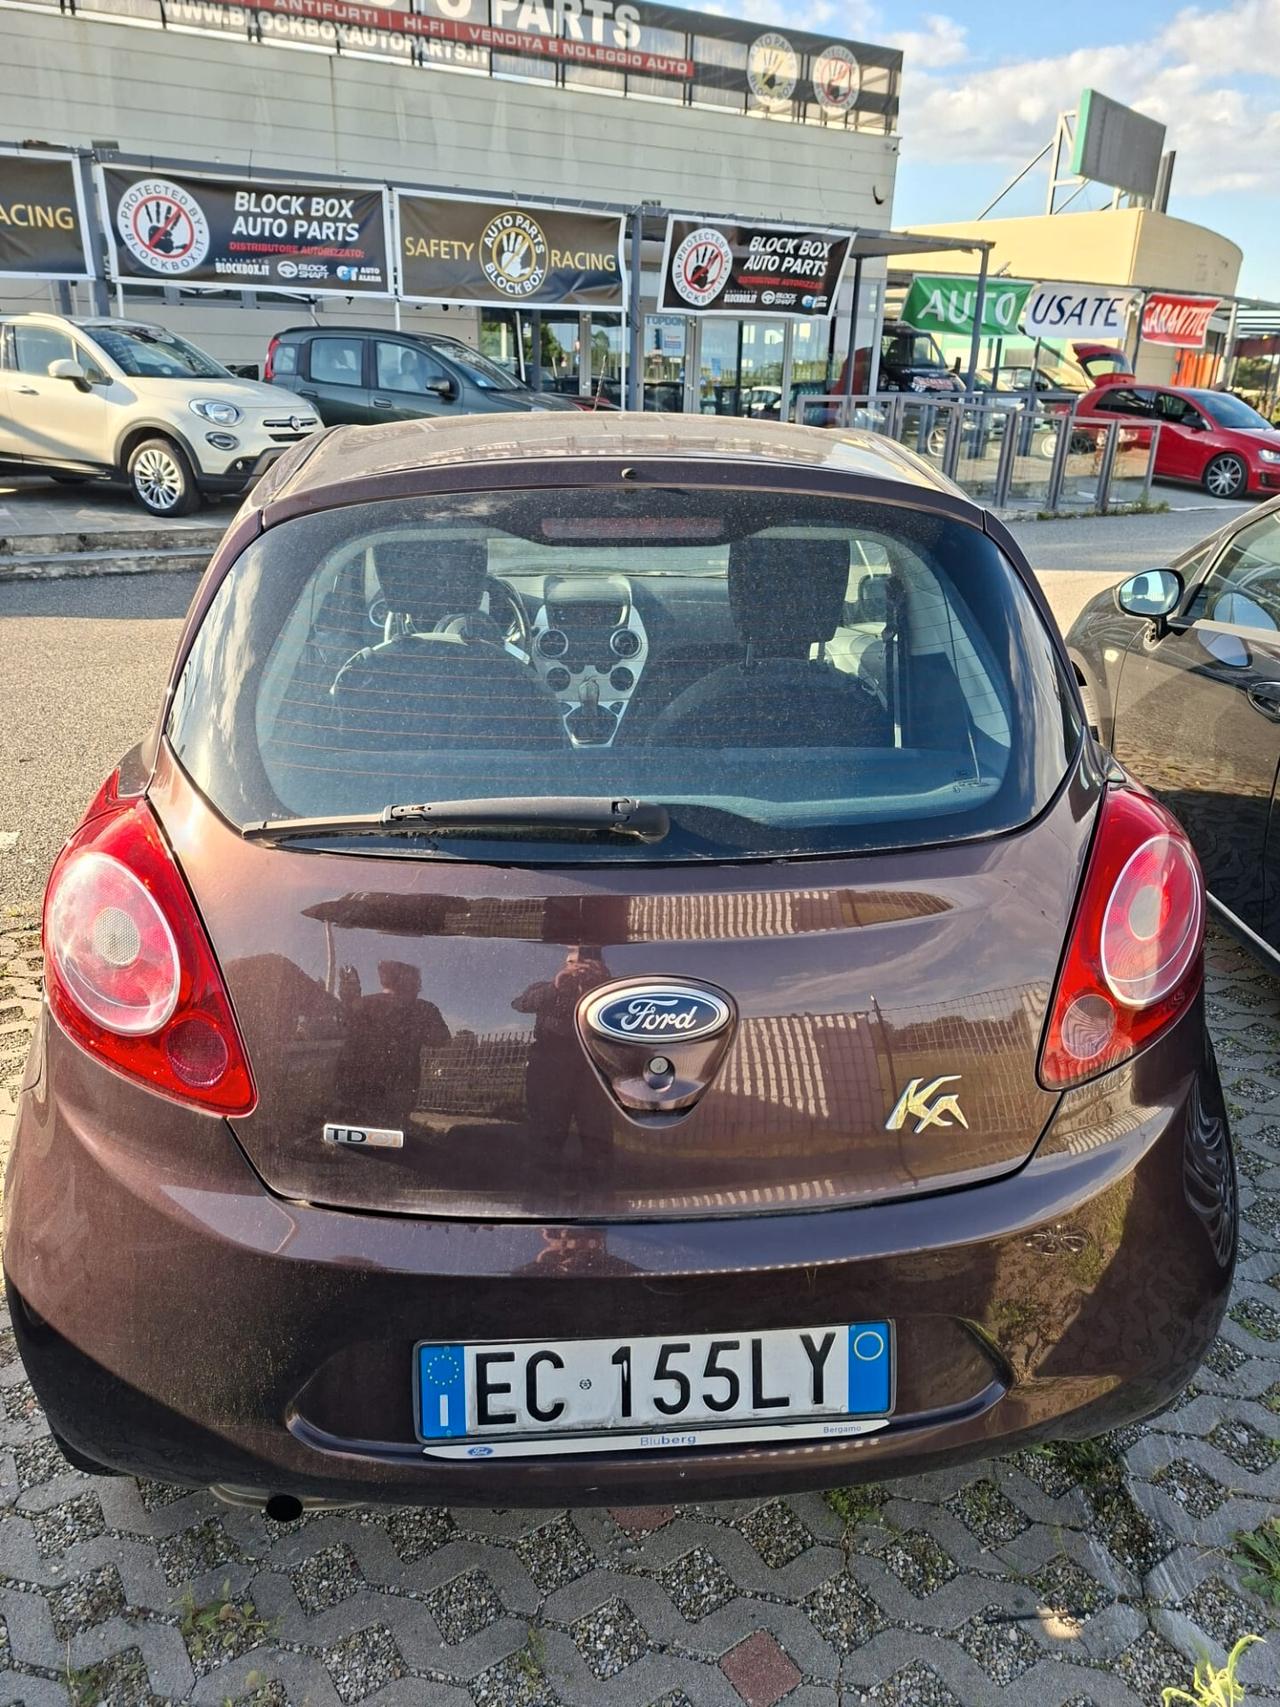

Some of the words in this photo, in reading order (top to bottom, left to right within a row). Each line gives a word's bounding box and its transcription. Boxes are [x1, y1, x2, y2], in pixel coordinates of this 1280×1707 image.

[273, 0, 379, 23] ANTIFURTI
[403, 16, 445, 34] HI-FI
[468, 27, 544, 50] VENDITA
[548, 40, 558, 52] E
[562, 43, 642, 67] NOLEGGIO
[646, 58, 688, 74] AUTO
[121, 185, 188, 220] PROTECTED
[188, 207, 204, 226] BY
[234, 191, 305, 216] BLOCK
[310, 197, 355, 219] BOX
[232, 216, 288, 238] AUTO
[293, 219, 360, 242] PARTS
[484, 215, 513, 248] AUTO
[515, 215, 545, 254] PARTS
[229, 241, 299, 254] DISTRIBUTORE
[404, 237, 475, 261] SAFETY
[550, 249, 617, 272] RACING
[749, 236, 800, 254] BLOCK
[798, 239, 833, 258] BOX
[743, 254, 780, 272] AUTO
[780, 256, 829, 277] PARTS
[917, 289, 1016, 326] AUTO
[1031, 293, 1125, 327] USATE
[620, 998, 698, 1031] Ford
[476, 1349, 566, 1426] EC
[611, 1331, 837, 1418] 155LY
[640, 1435, 697, 1447] Bluberg
[823, 1425, 862, 1435] Bergamo
